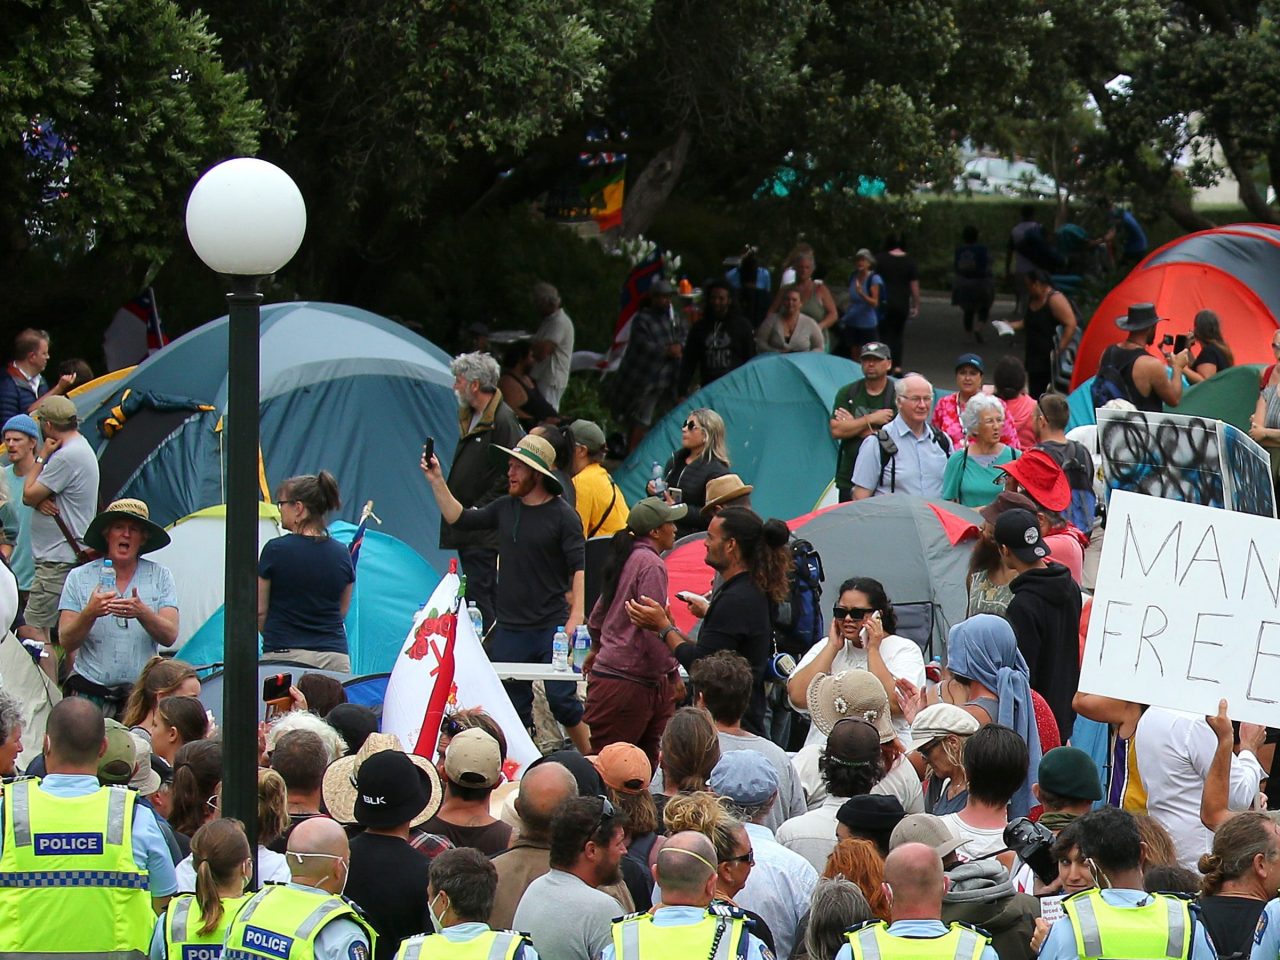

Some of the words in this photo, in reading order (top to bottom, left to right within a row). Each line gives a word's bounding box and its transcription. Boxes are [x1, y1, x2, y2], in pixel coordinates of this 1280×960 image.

[363, 795, 387, 805] BLK
[40, 837, 97, 850] POLICE
[246, 930, 288, 952] POLICE
